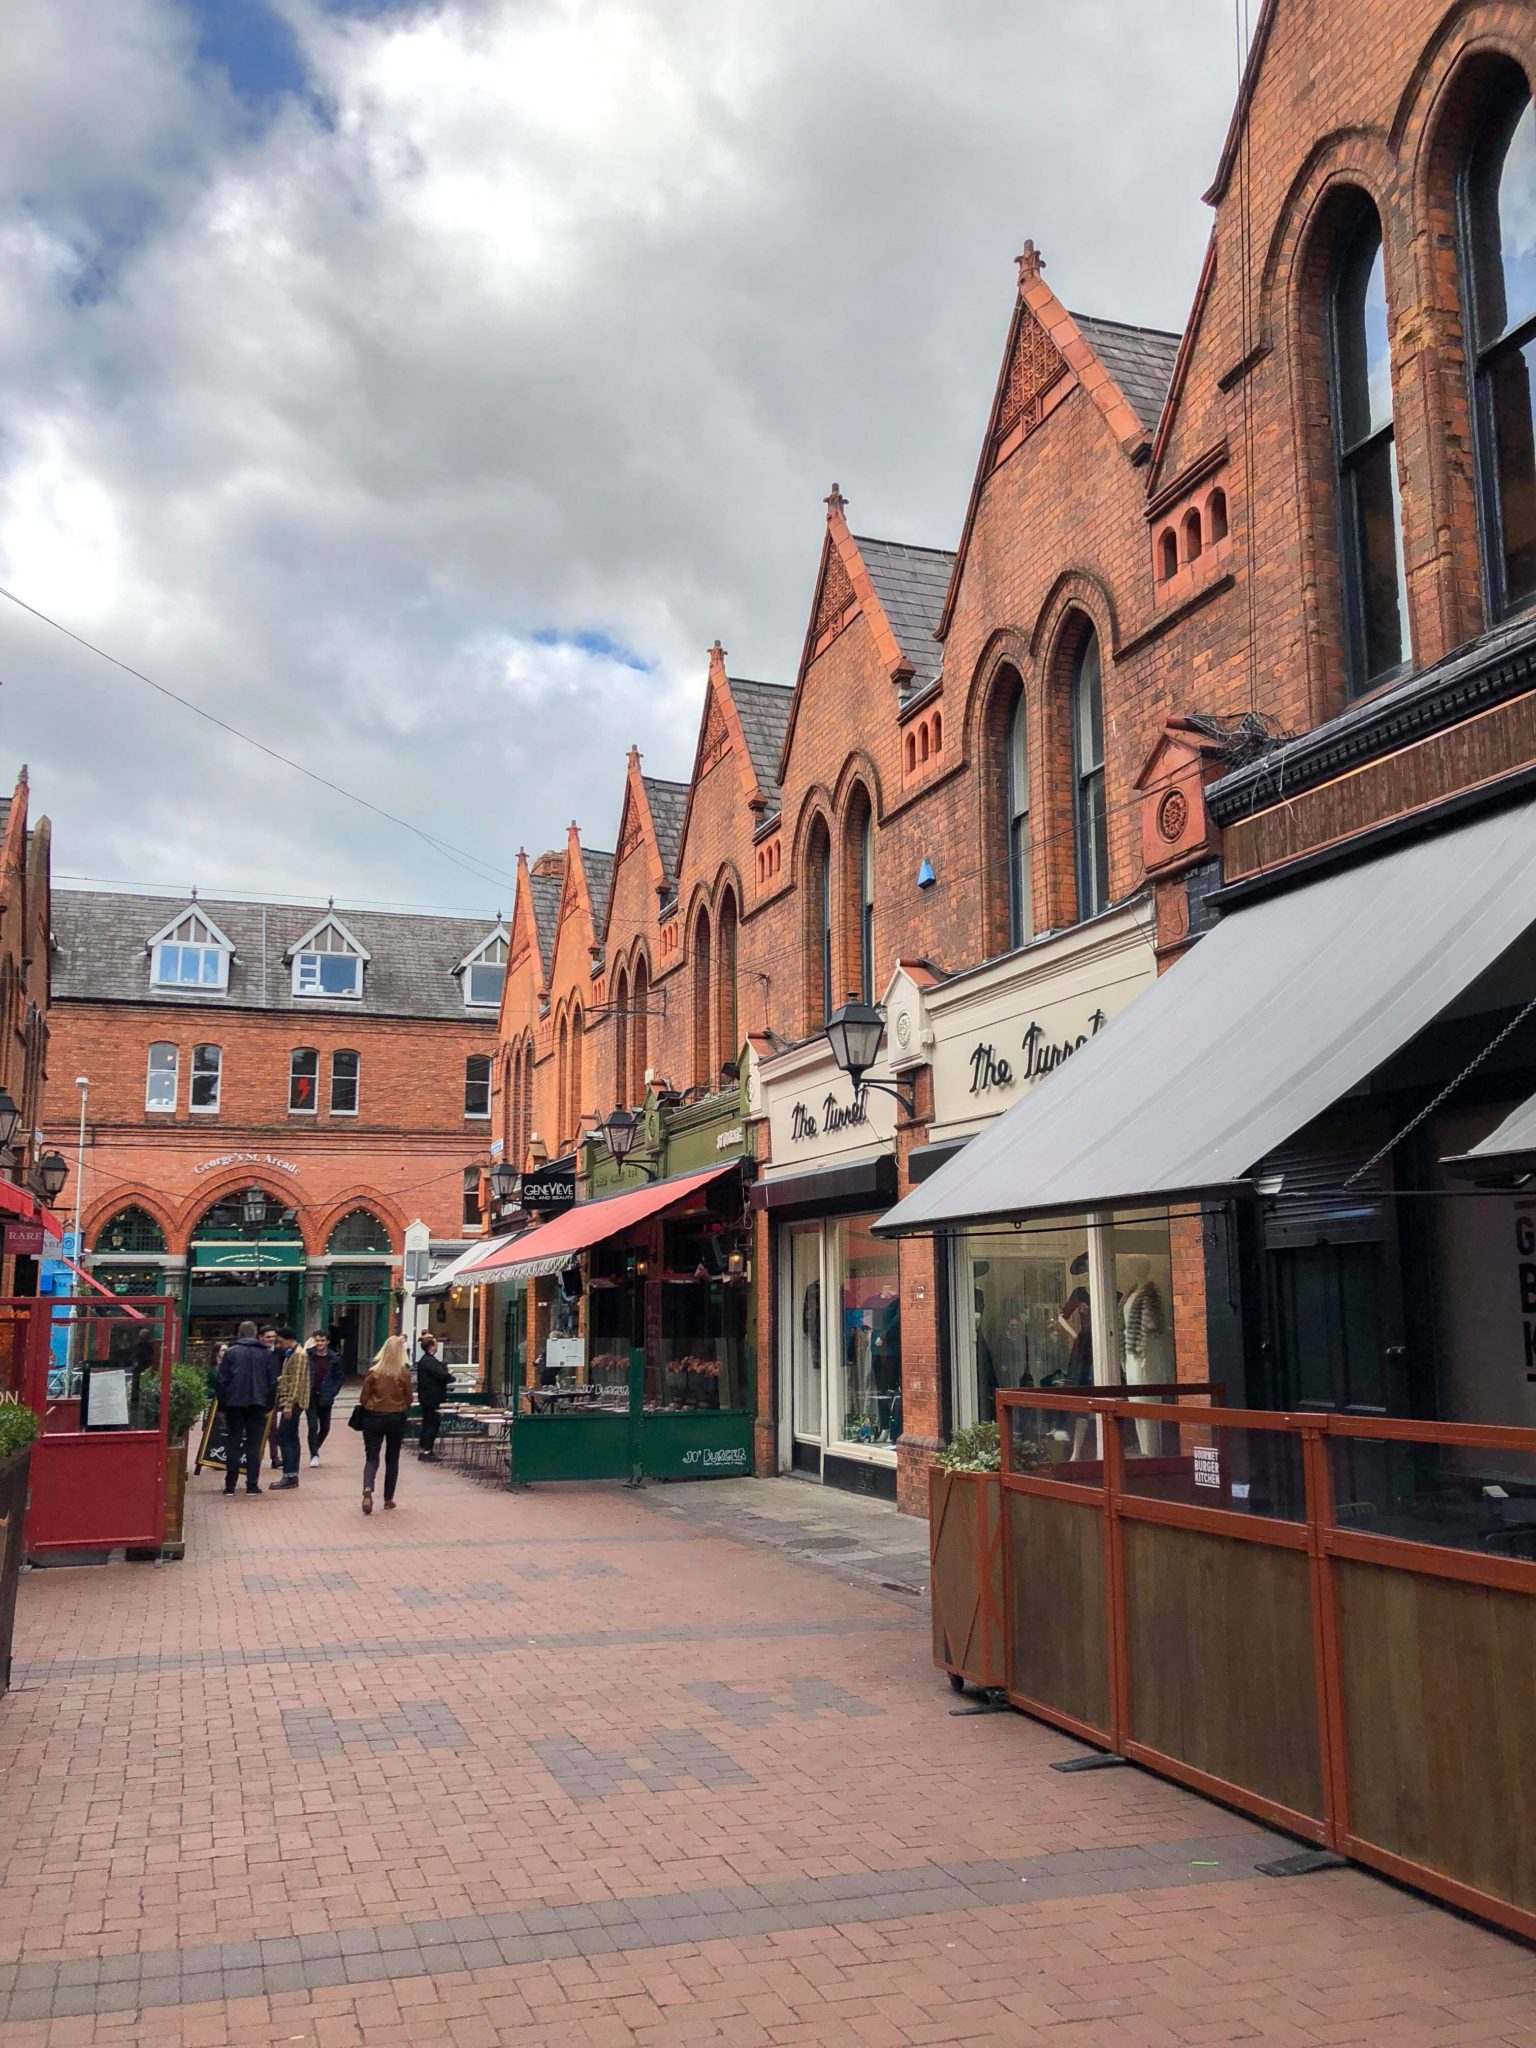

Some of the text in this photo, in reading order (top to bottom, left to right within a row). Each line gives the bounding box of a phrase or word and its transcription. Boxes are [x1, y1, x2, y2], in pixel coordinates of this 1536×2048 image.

[969, 1042, 1013, 1093] The
[791, 1101, 817, 1140] The
[193, 1152, 244, 1174] George's
[263, 1153, 300, 1175] Arcade
[8, 1231, 42, 1241] RARE
[703, 1447, 747, 1463] BURGER
[1193, 1450, 1218, 1461] GOURMET
[1194, 1460, 1219, 1473] BURGER
[1195, 1472, 1220, 1485] KITCHEN
